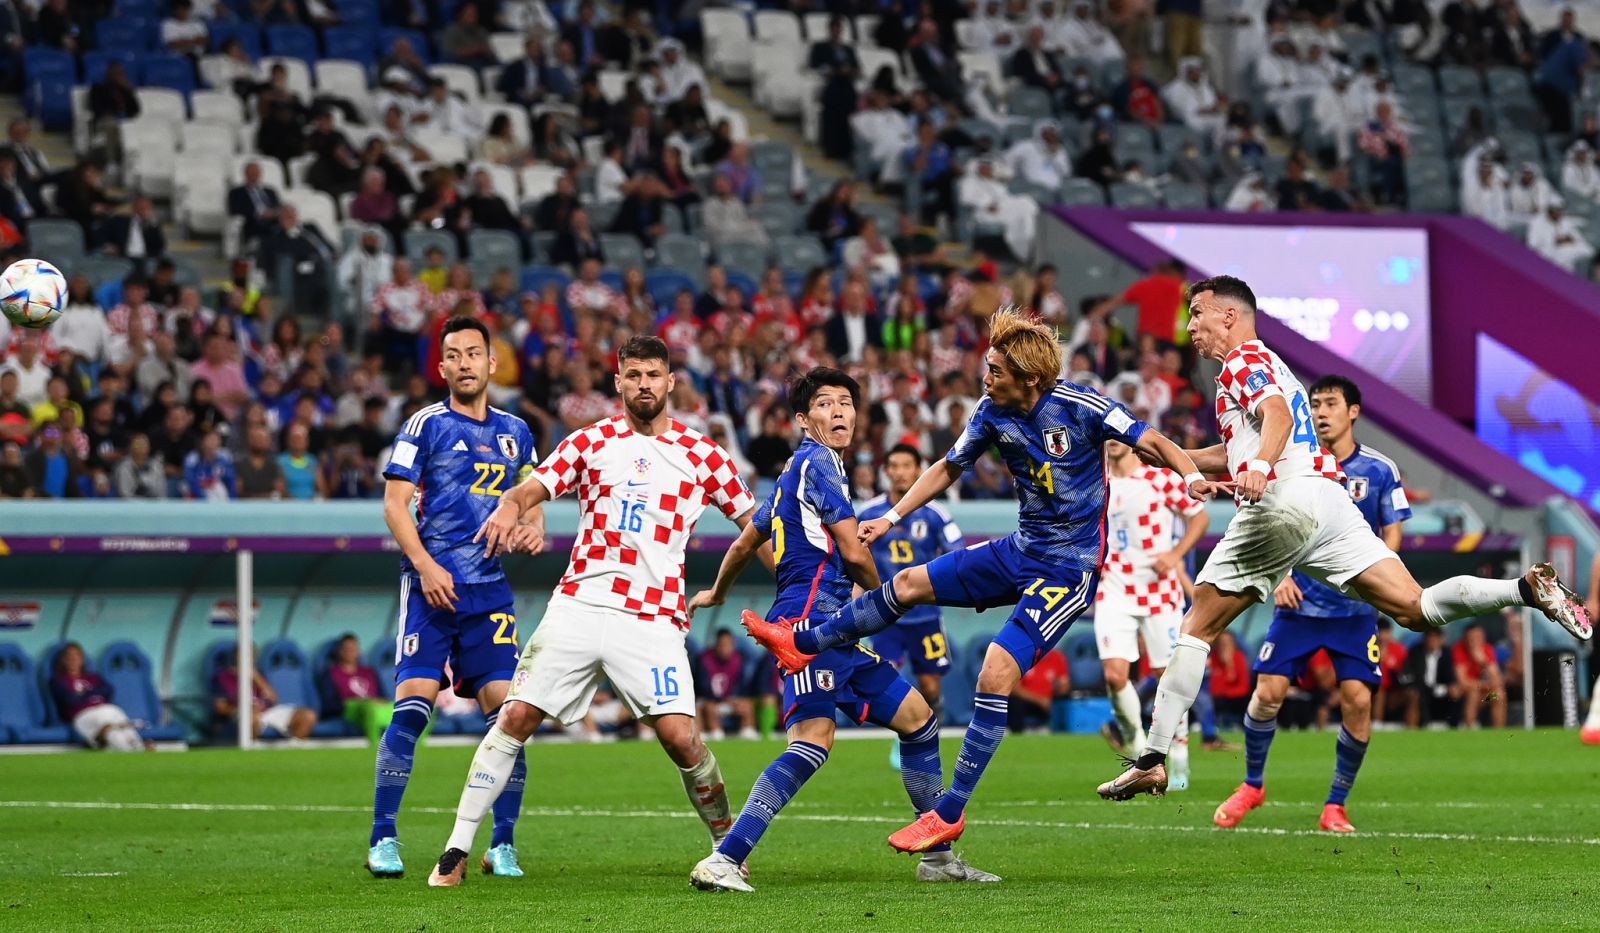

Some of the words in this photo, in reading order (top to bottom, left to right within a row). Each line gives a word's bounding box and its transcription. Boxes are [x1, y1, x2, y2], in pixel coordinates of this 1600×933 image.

[469, 462, 506, 497] 22
[618, 500, 646, 534] 16
[888, 540, 914, 564] 13
[1116, 529, 1128, 550] 9
[1023, 577, 1070, 612] 14
[922, 632, 946, 660] 13
[1367, 634, 1380, 663] 6
[651, 666, 679, 697] 16
